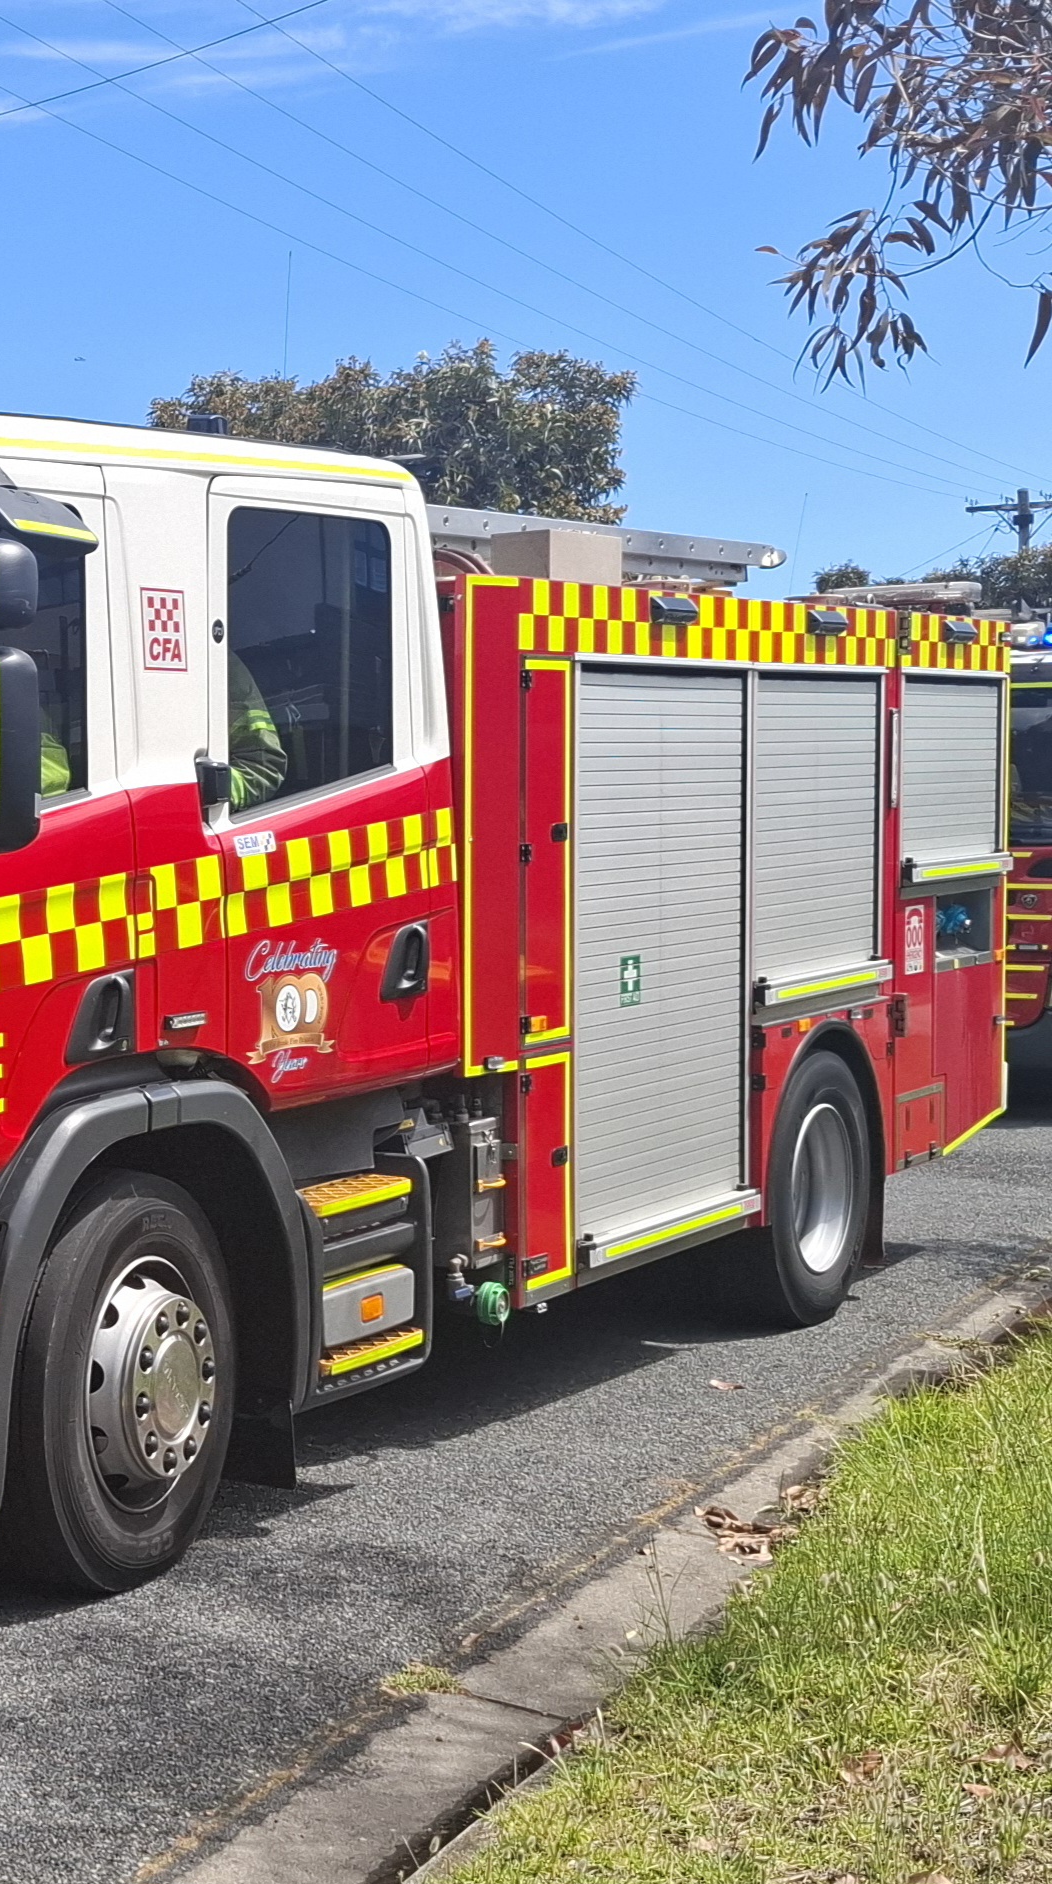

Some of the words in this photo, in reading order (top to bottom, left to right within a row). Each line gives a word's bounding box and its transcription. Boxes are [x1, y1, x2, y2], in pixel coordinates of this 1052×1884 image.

[149, 637, 182, 662] CFA
[237, 836, 260, 850] SEM
[245, 938, 337, 983] Celebrating
